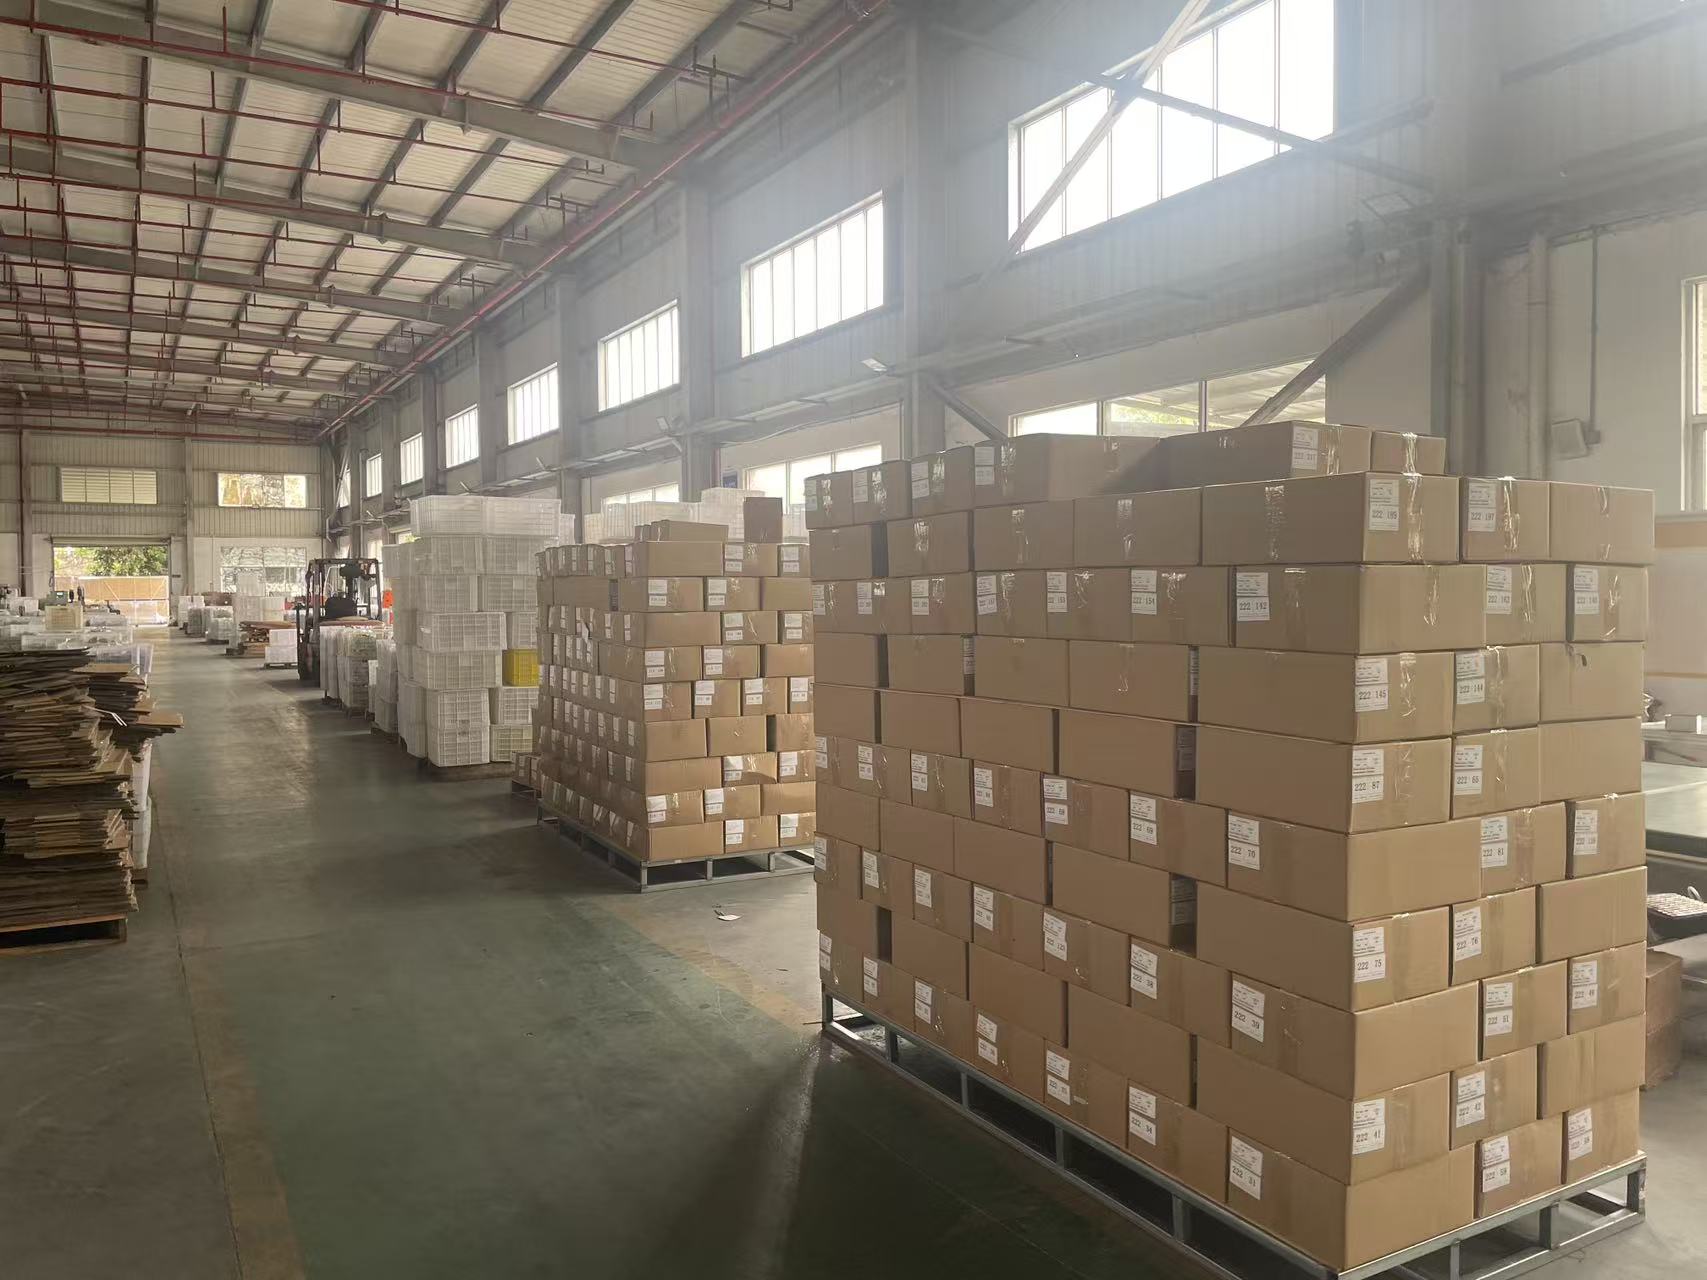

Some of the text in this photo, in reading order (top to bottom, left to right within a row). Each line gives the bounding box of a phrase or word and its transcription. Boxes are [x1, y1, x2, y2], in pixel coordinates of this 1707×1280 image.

[1371, 510, 1383, 519] 222
[1470, 512, 1481, 520] 222
[1239, 602, 1251, 611] 222
[1358, 691, 1371, 700] 222
[1456, 775, 1467, 785] 222
[1354, 782, 1366, 792] 222
[1230, 845, 1242, 855] 222
[1456, 940, 1467, 950] 222
[1357, 961, 1369, 971] 222
[1234, 1011, 1246, 1023] 222
[1488, 1016, 1498, 1025] 222
[1356, 1133, 1368, 1143] 222
[1232, 1165, 1243, 1178] 222
